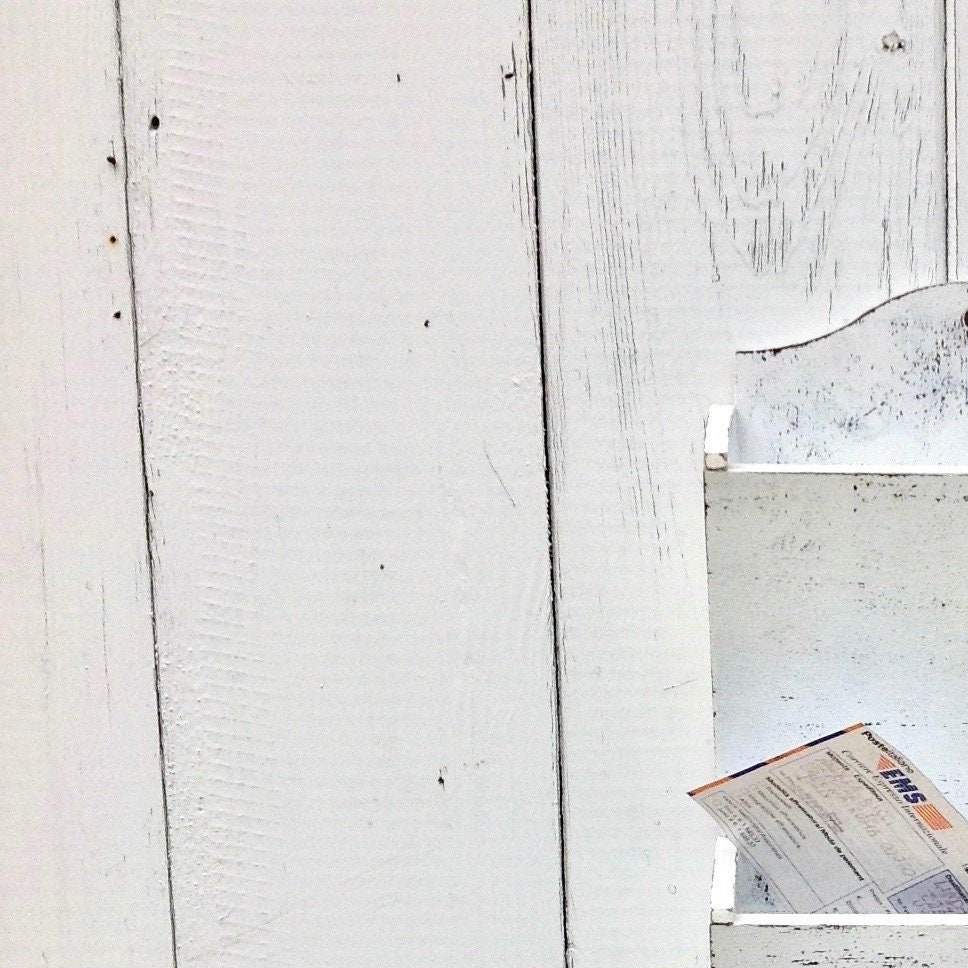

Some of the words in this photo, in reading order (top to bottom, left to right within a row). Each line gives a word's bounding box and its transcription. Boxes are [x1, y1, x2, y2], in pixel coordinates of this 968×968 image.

[841, 749, 872, 774] Corriere
[901, 806, 949, 855] Internazionale
[880, 769, 927, 804] EMS
